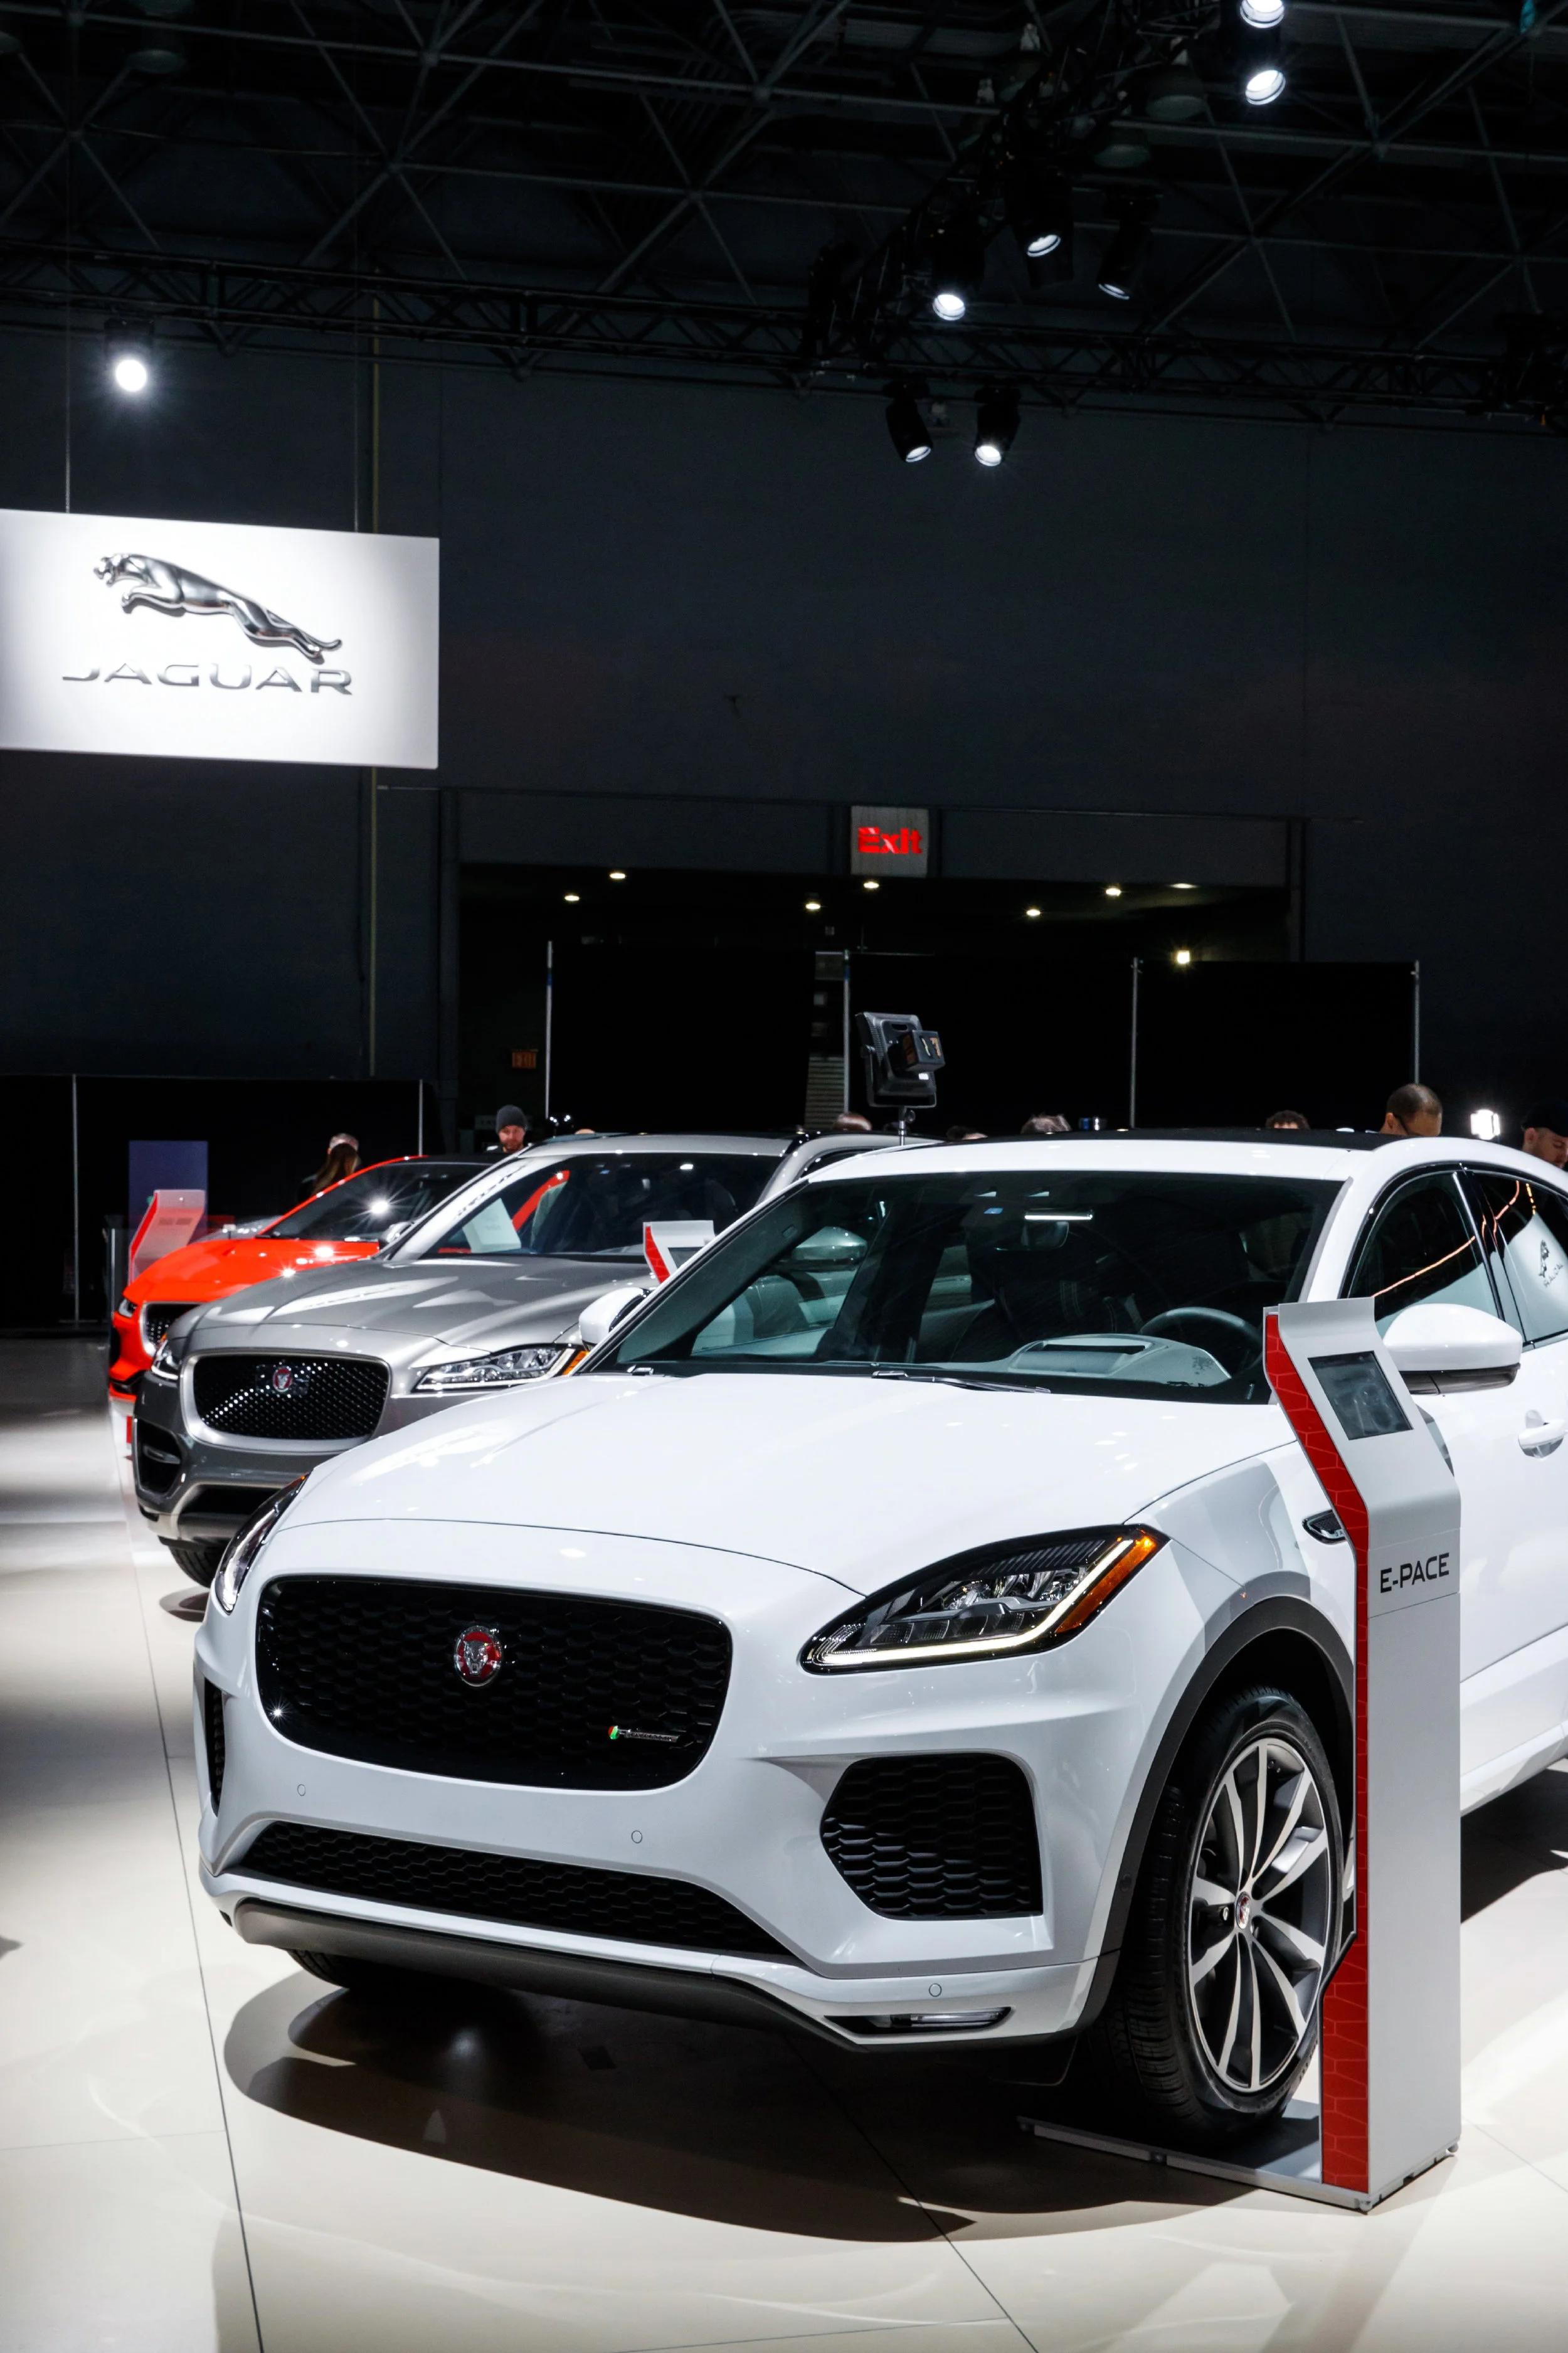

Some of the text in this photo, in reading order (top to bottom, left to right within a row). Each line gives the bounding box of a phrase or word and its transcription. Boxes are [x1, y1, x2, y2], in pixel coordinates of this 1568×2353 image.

[62, 662, 352, 696] JAGUAR
[857, 826, 923, 854] Exit
[1380, 1552, 1450, 1593] E-PACE
